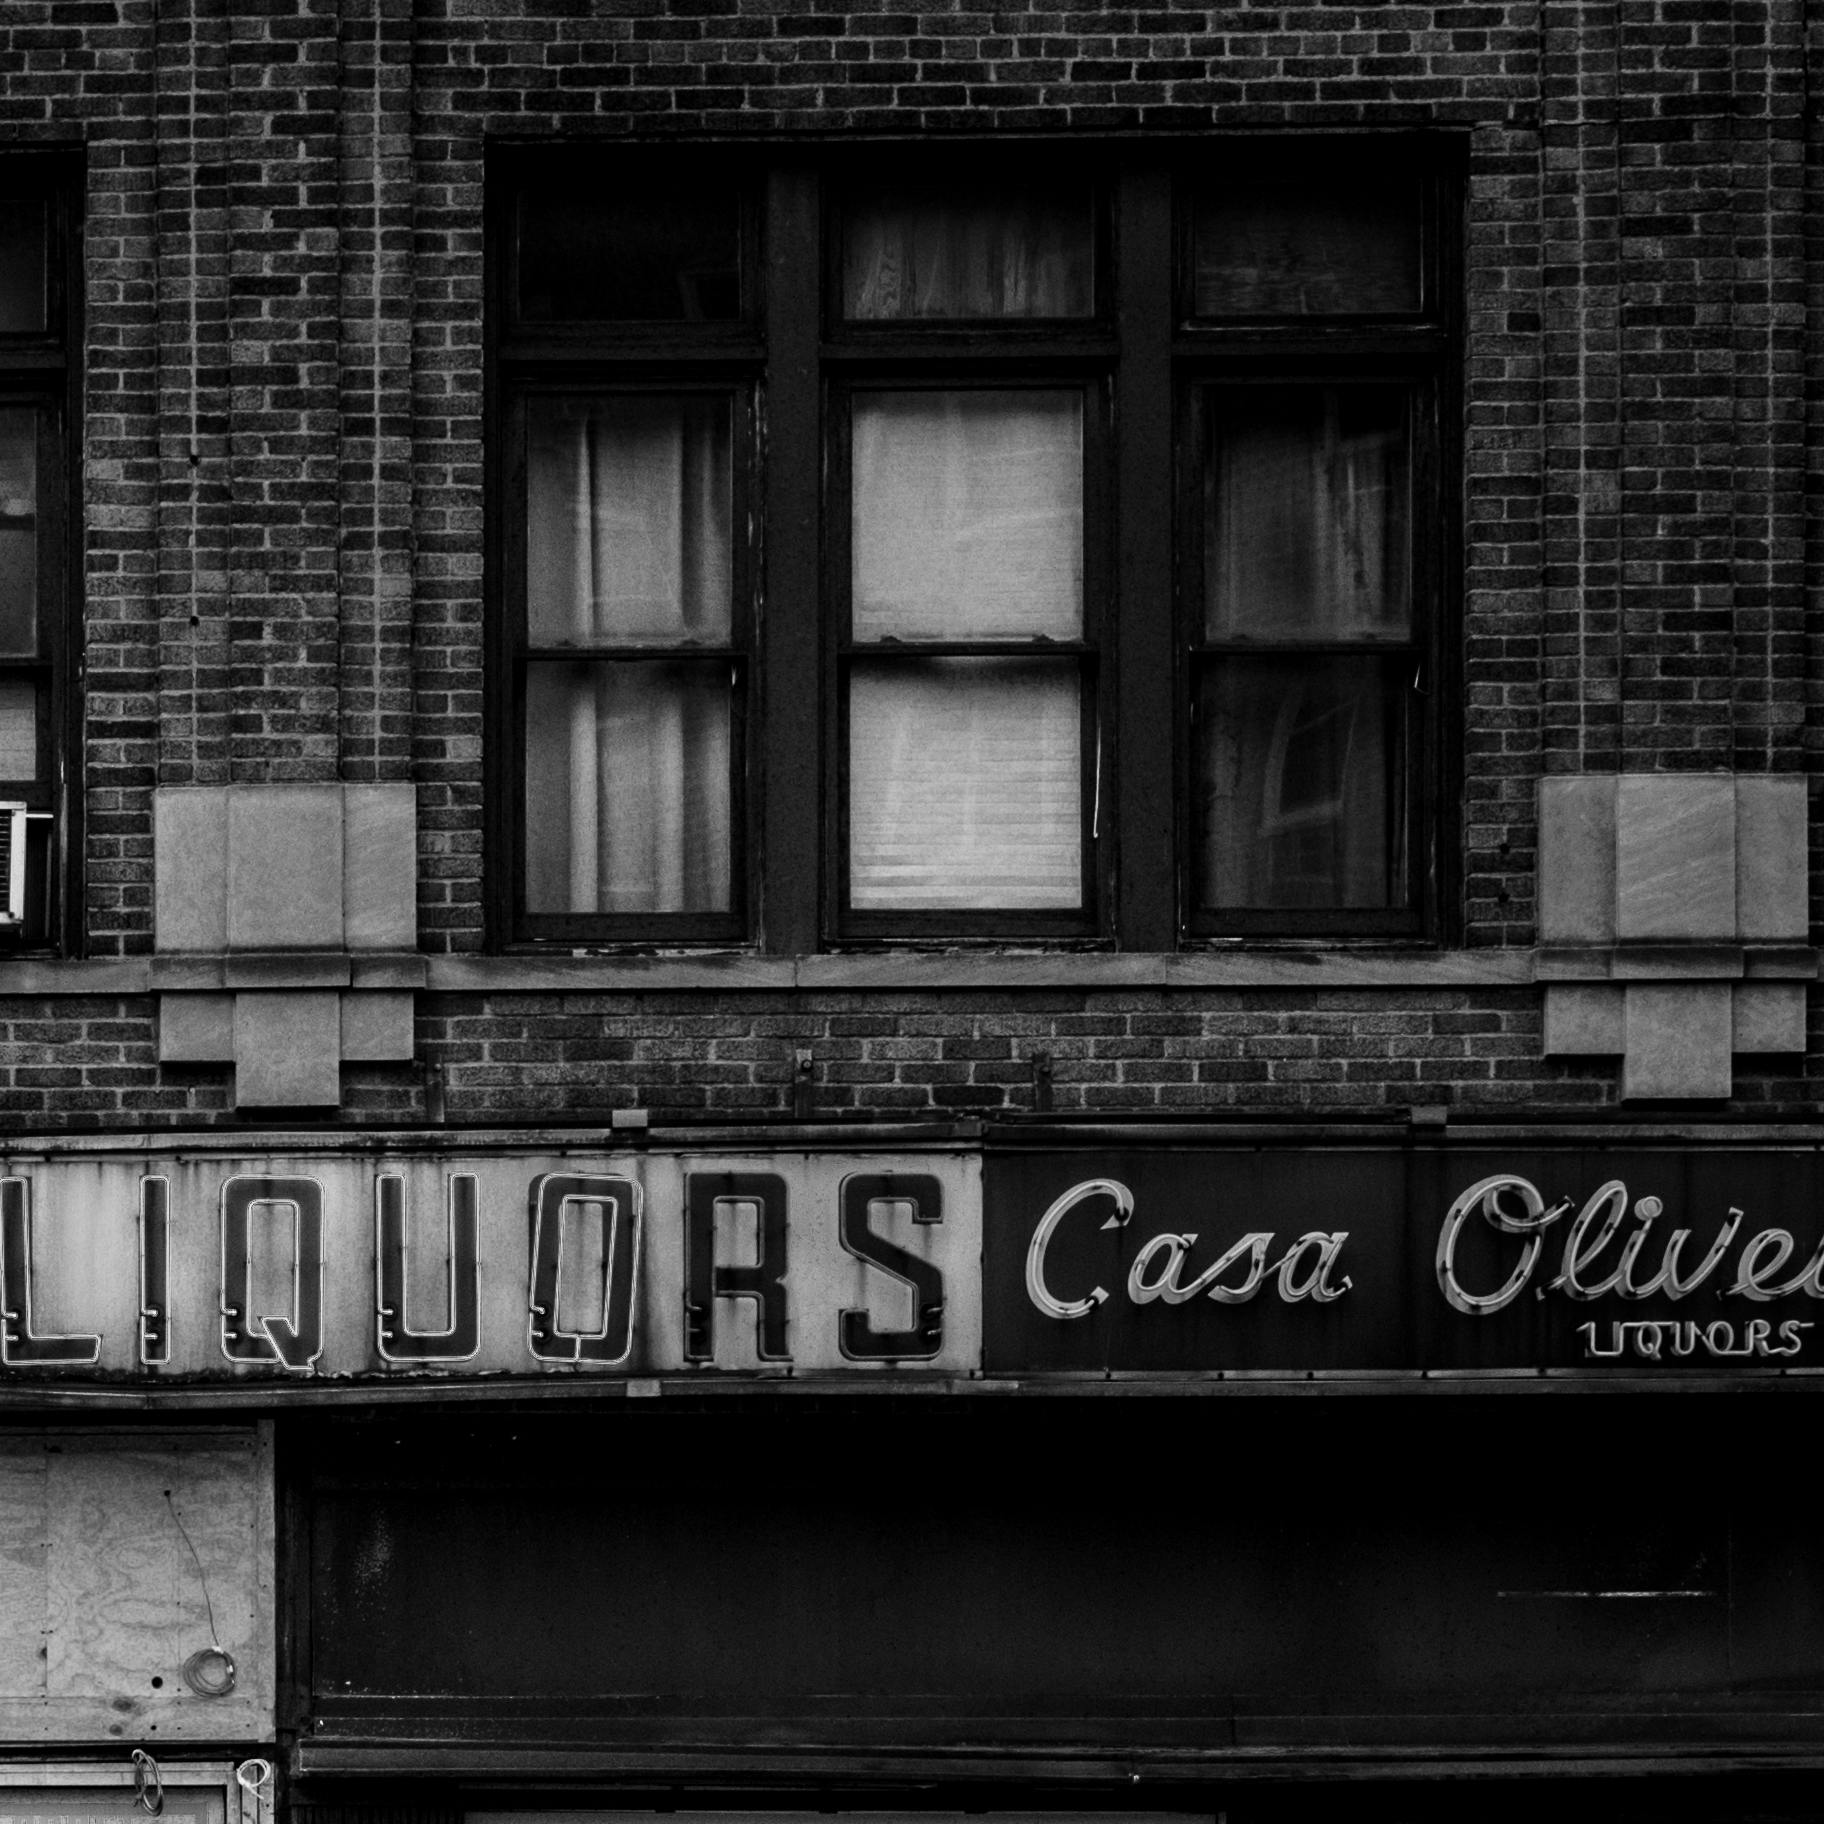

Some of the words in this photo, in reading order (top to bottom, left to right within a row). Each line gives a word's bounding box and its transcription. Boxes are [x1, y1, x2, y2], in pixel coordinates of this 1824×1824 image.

[0, 1172, 944, 1372] LIQUORS
[1026, 1178, 1352, 1318] Casa
[1577, 1321, 1813, 1358] LIQUORS
